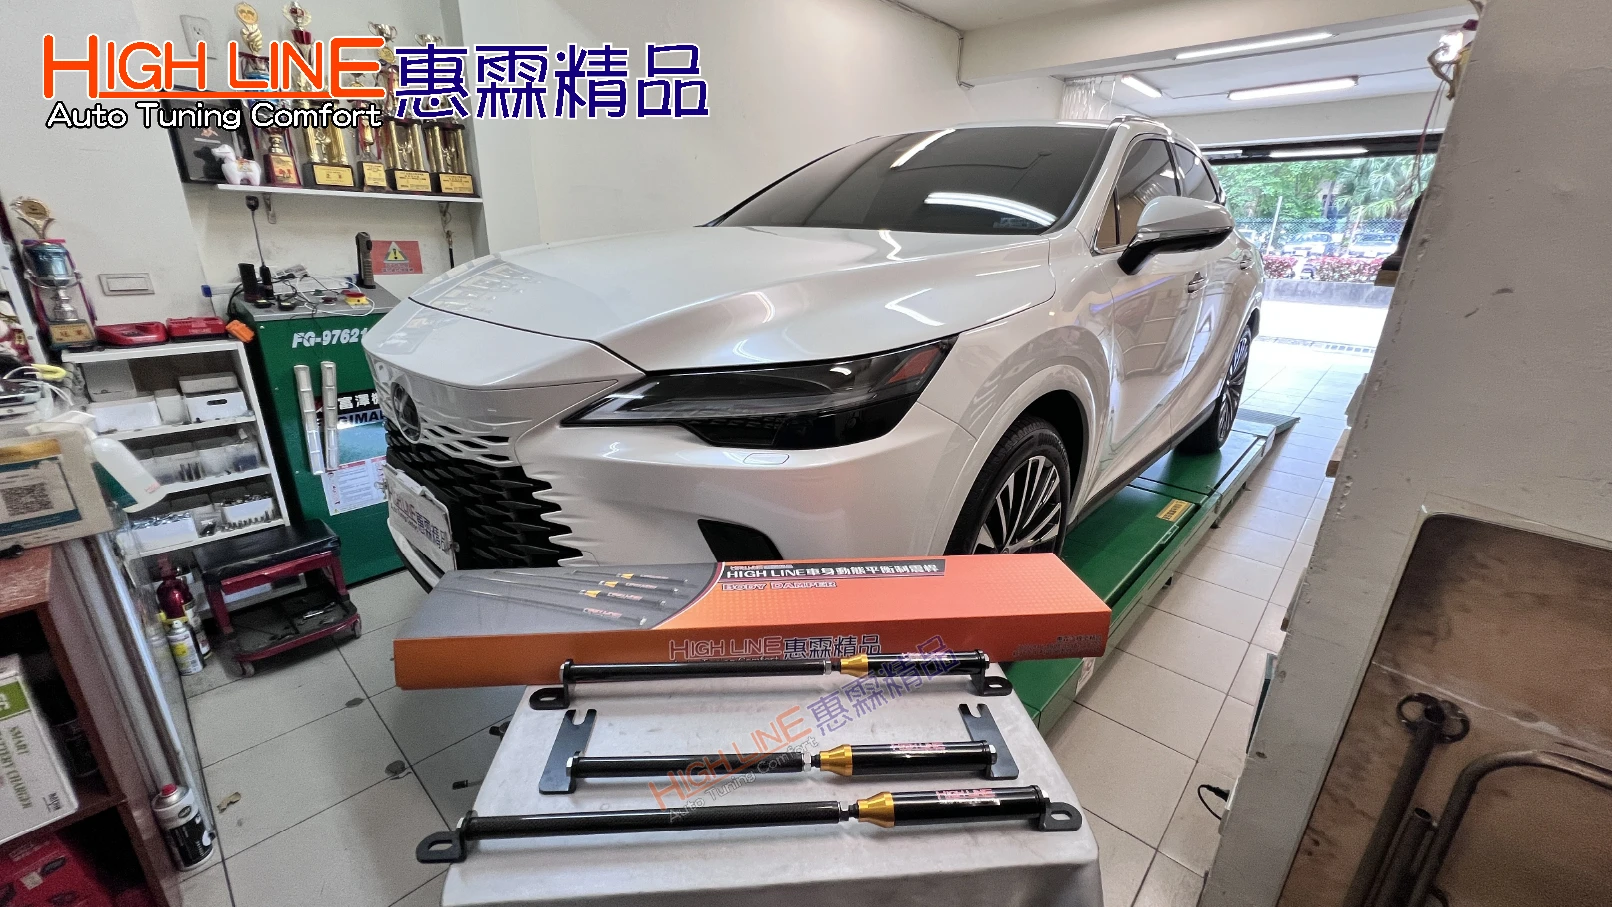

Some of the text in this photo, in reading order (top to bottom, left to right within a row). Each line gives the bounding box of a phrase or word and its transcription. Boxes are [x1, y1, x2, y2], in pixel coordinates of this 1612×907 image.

[726, 569, 767, 578] HIGH
[722, 580, 838, 591] BODY DAMPER
[668, 636, 783, 661] HIGH LINE
